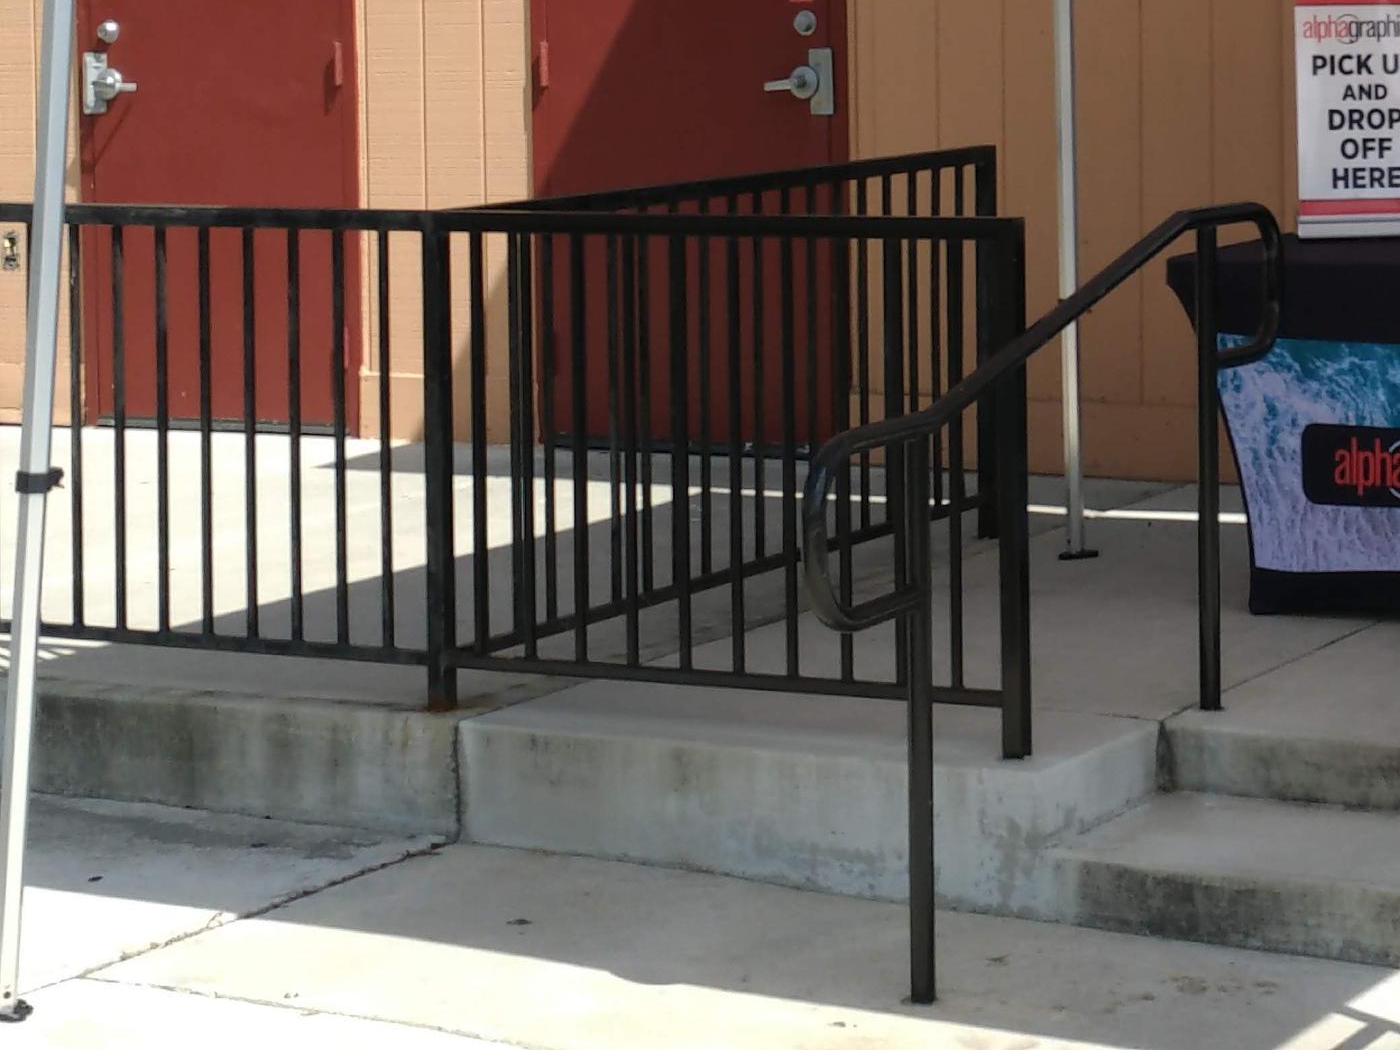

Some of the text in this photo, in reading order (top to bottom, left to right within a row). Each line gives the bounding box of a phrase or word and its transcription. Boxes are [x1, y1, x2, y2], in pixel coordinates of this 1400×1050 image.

[1312, 54, 1374, 76] PICK
[1342, 83, 1388, 101] AND
[1340, 137, 1393, 160] OFF
